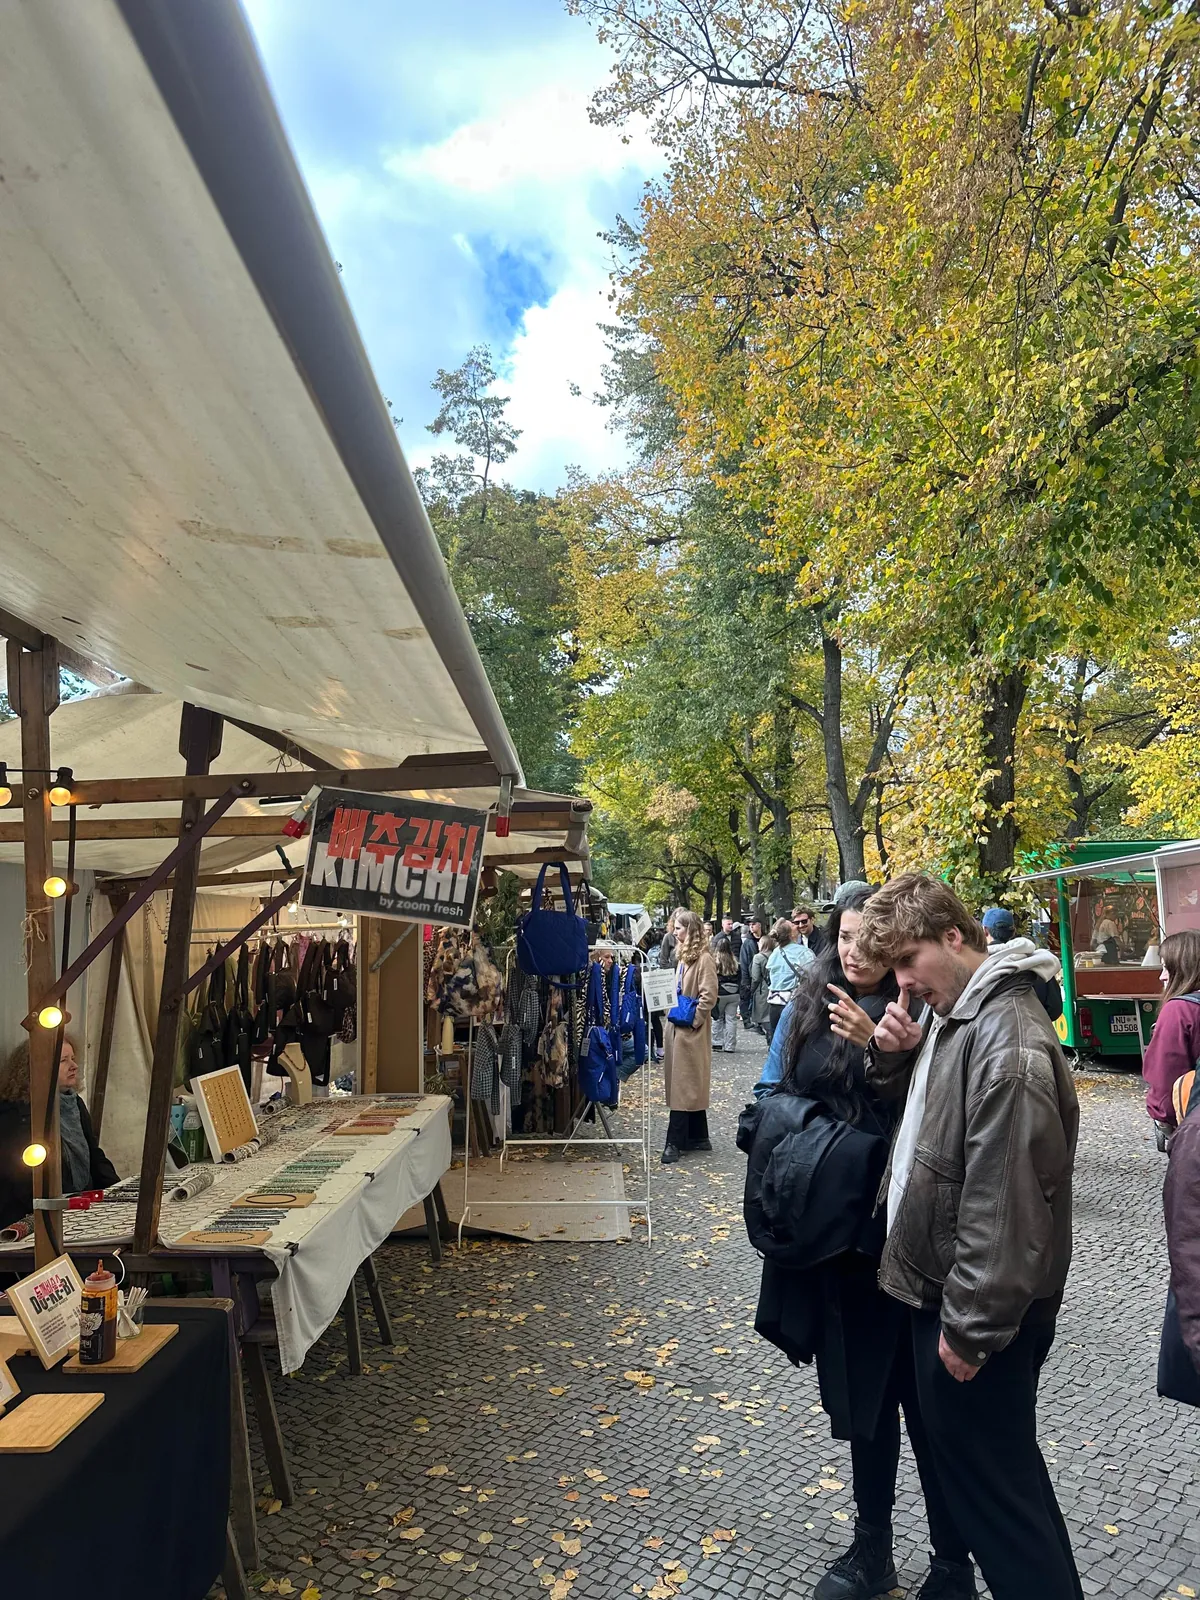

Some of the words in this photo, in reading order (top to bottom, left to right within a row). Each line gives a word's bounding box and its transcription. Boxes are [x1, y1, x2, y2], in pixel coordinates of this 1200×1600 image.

[327, 807, 481, 876] 배추김치
[310, 841, 471, 904] KIMCHI
[379, 896, 394, 909] by
[396, 900, 431, 911] zoom
[433, 902, 464, 917] fresh
[1115, 1016, 1126, 1024] NU
